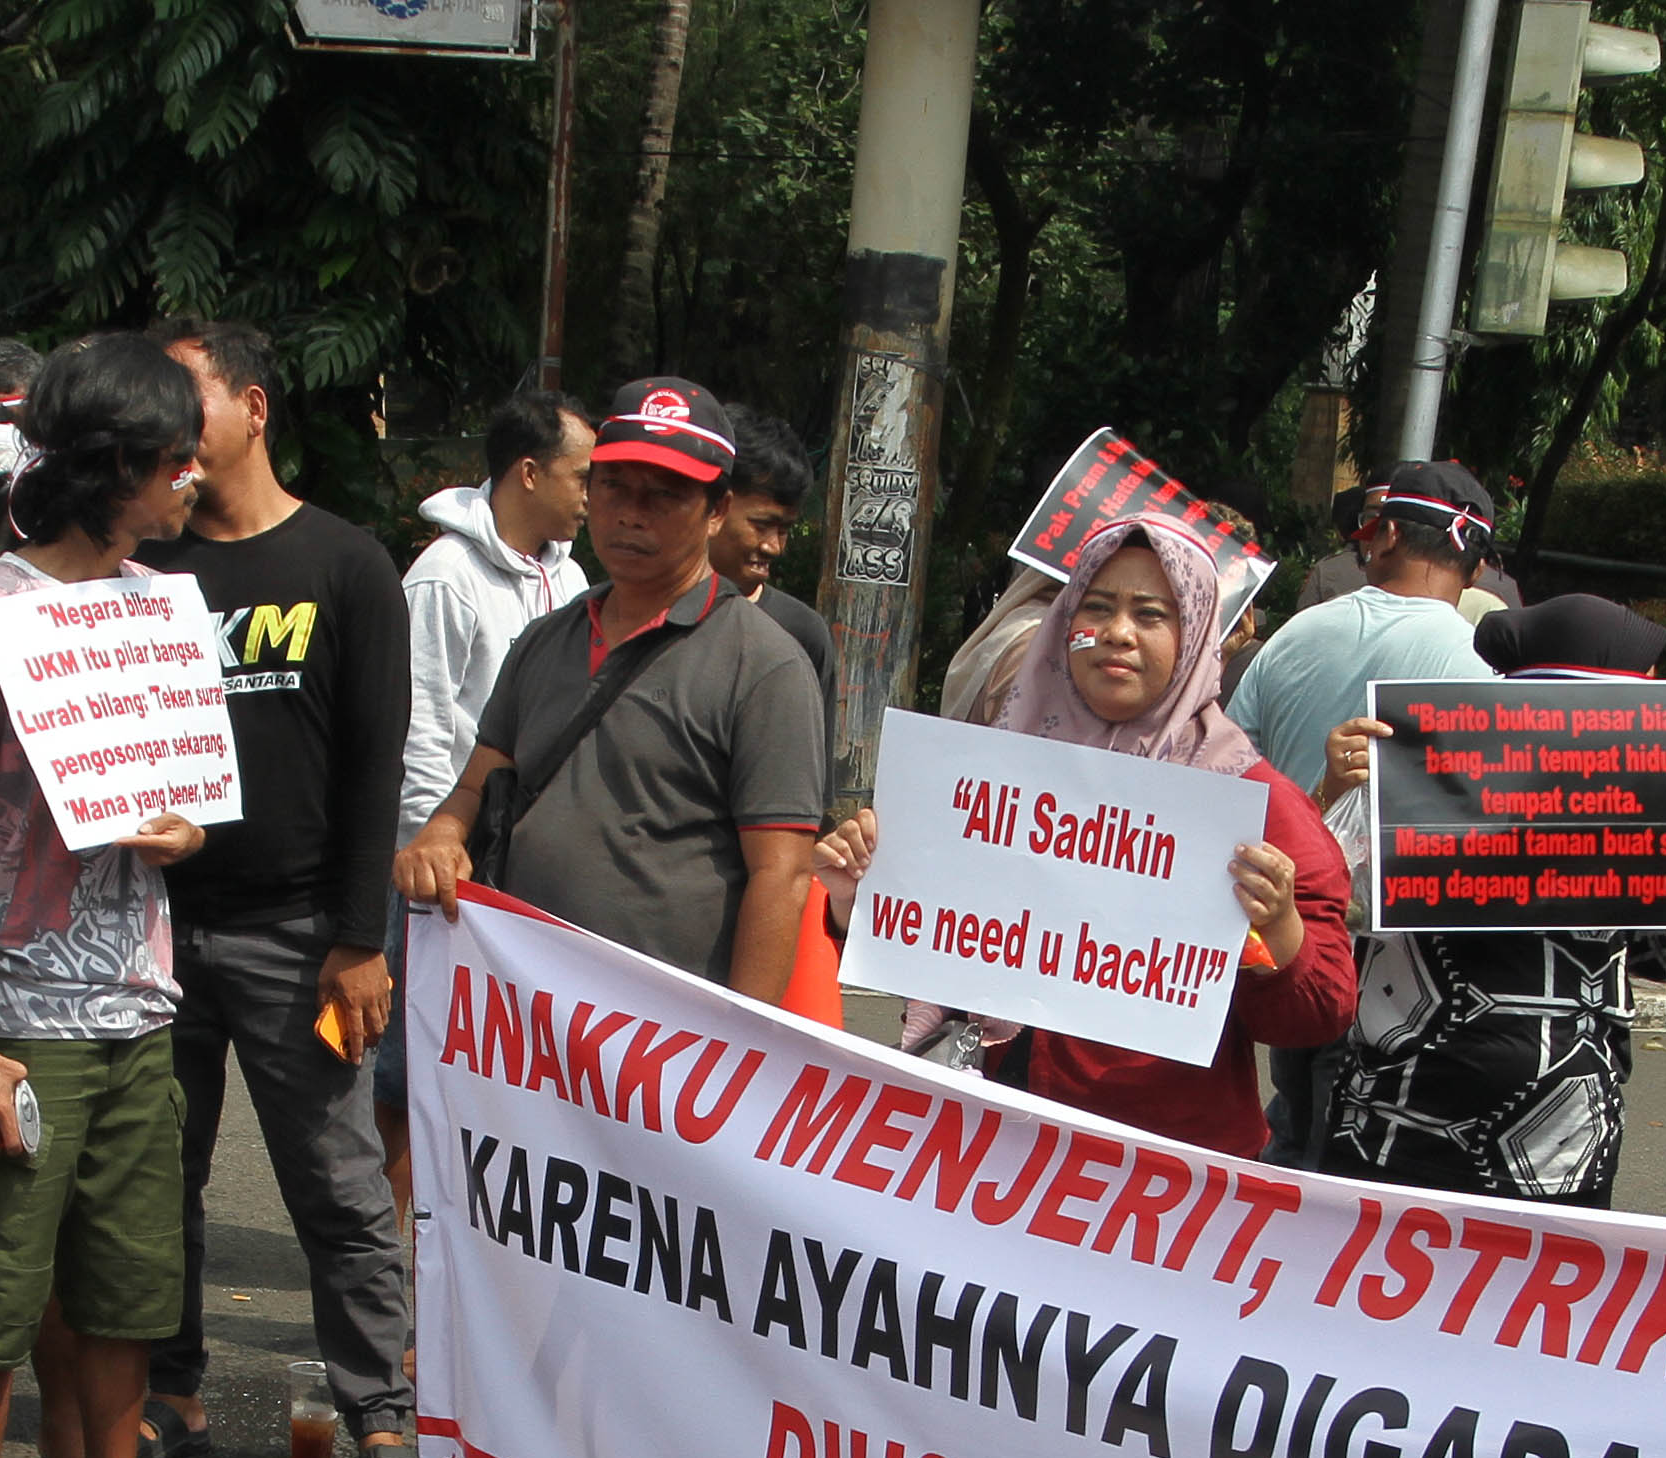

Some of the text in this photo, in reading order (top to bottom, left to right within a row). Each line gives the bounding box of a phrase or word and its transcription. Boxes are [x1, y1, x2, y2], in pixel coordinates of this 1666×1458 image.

[848, 468, 918, 496] SQUIDY
[1098, 473, 1146, 518] Hatta
[1034, 510, 1074, 550] Pak
[1063, 462, 1108, 509] Pram
[845, 547, 903, 582] ASS
[37, 592, 175, 629] "Negara bilang:
[208, 602, 318, 668] KM
[24, 639, 204, 682] UKM itu pilar bangsa.
[221, 674, 296, 691] SANTARA
[17, 705, 85, 736] Lurah
[91, 695, 146, 723] bilang:
[195, 682, 226, 707] surat
[1407, 703, 1491, 733] "Barito
[1495, 704, 1565, 732] bukan
[1571, 709, 1635, 737] pasar
[50, 732, 227, 783] pengosongan sekarang.
[1538, 745, 1621, 780] tempat
[63, 790, 130, 825] 'Mana
[133, 788, 166, 819] yang
[169, 781, 202, 809] bener,
[1481, 786, 1644, 820] tempat cerita.
[1028, 792, 1176, 881] Sadikin
[1395, 827, 1457, 858] Masa
[1462, 827, 1519, 857] demi
[1525, 827, 1596, 857] taman
[1603, 826, 1654, 857] buat
[1384, 875, 1440, 906] yang
[1446, 869, 1530, 906] dagang
[1535, 868, 1622, 898] disuruh
[871, 893, 923, 946] we
[932, 906, 1031, 970] need
[1038, 928, 1064, 977] u
[440, 963, 769, 1147] ANAKKU
[753, 1062, 1304, 1322] MENJERIT,
[461, 1126, 734, 1324] KARENA
